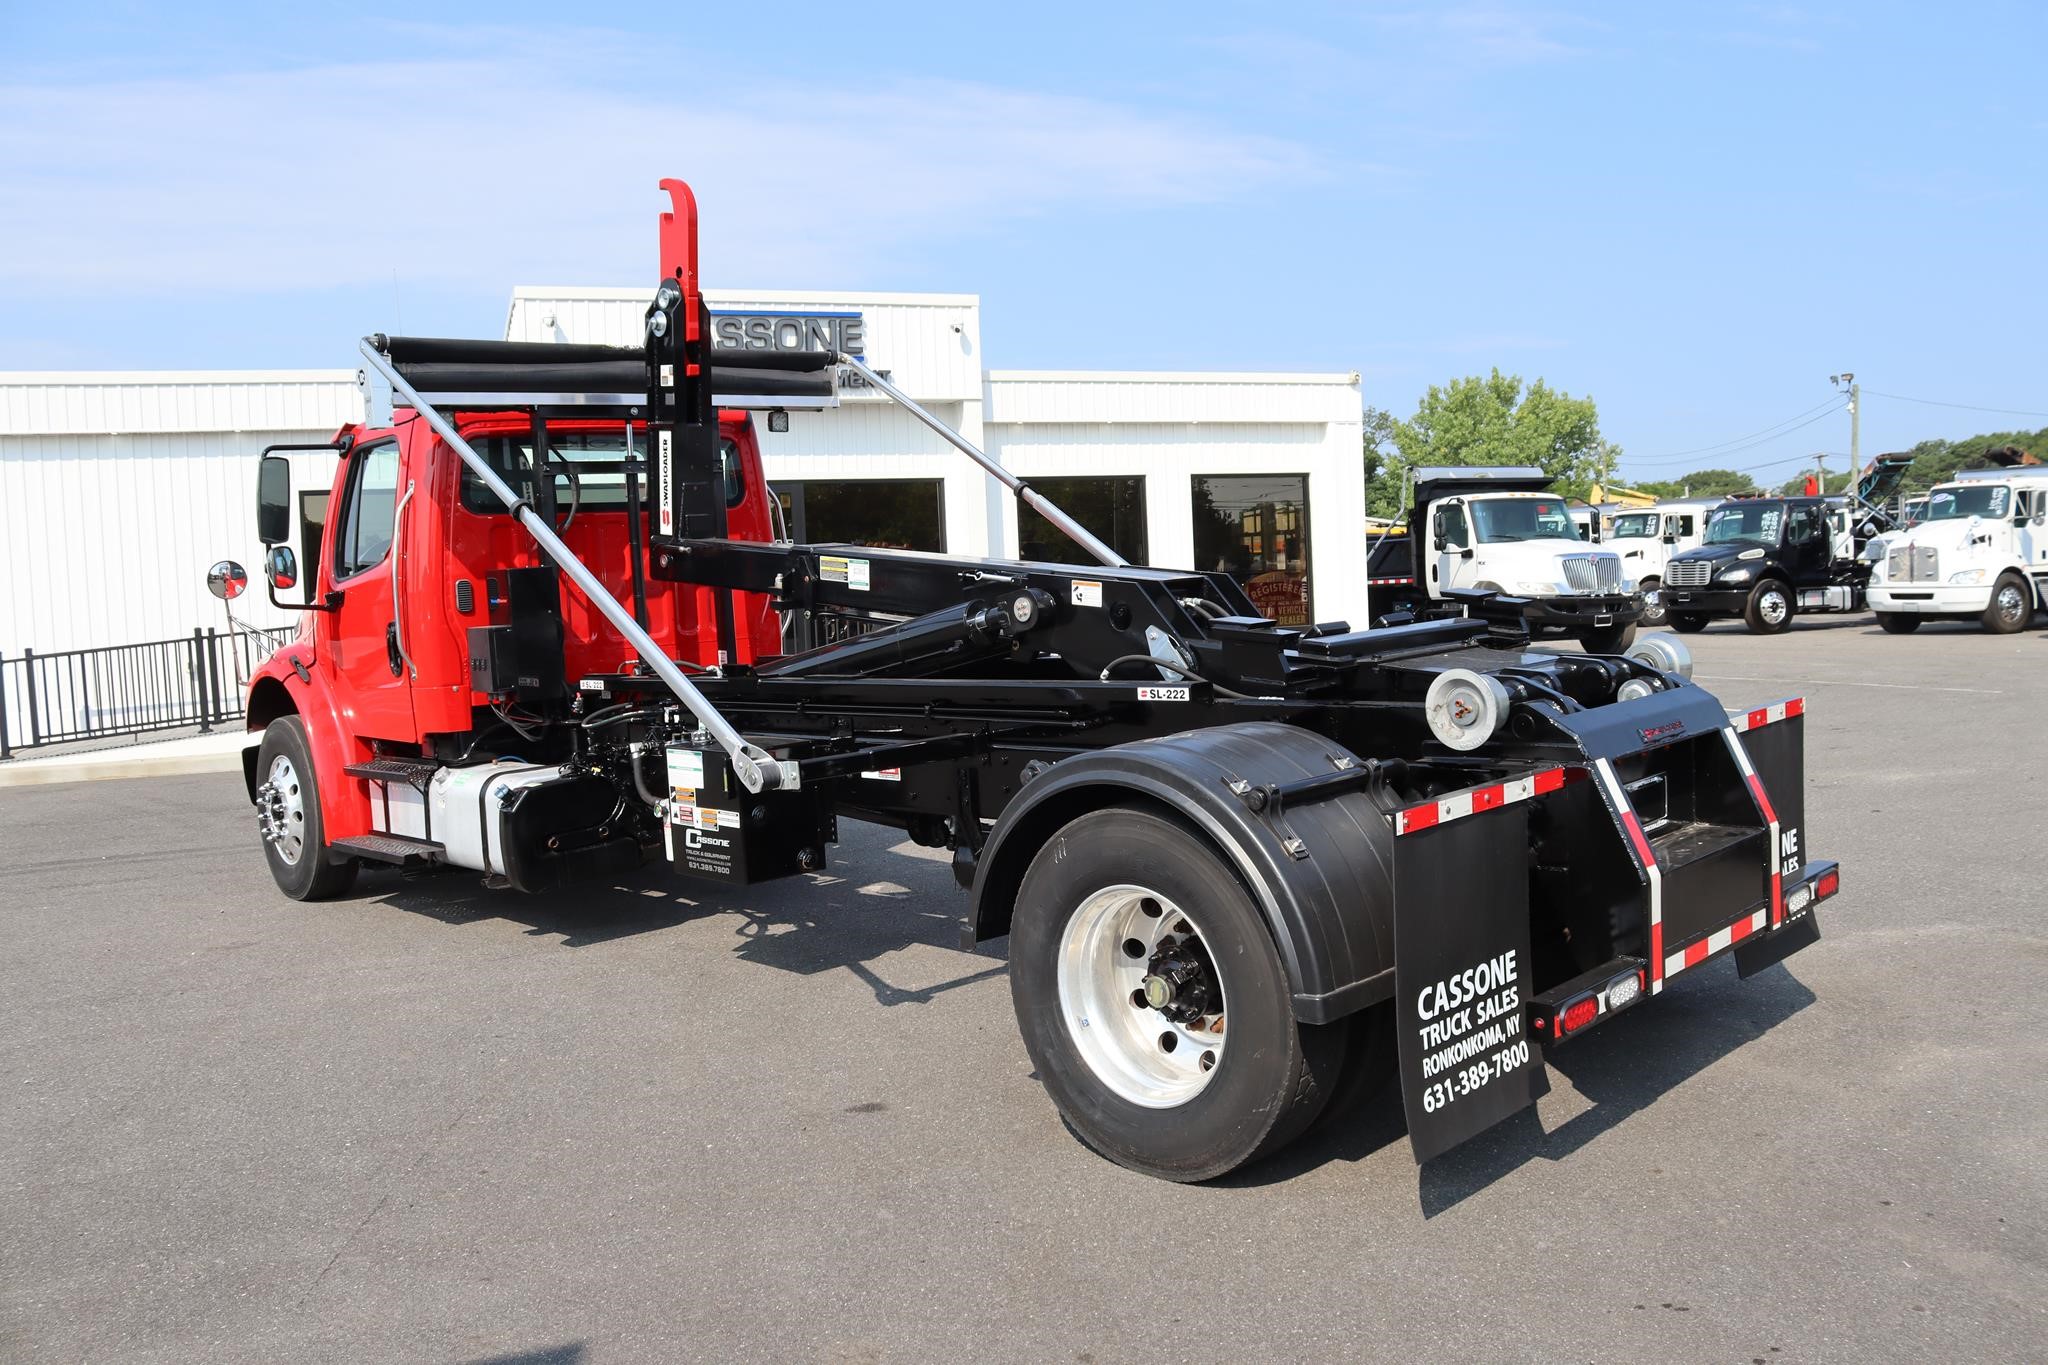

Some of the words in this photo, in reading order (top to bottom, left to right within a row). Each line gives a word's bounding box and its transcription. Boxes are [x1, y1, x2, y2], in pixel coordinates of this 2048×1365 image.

[711, 317, 863, 353] SSONE
[1150, 689, 1186, 699] SL-222
[1782, 856, 1799, 876] LES
[1418, 949, 1518, 1021] CASSONE
[1419, 1007, 1472, 1050] TRUCK
[1477, 986, 1519, 1025] SALES
[1422, 1023, 1506, 1079] RONKONKOMA,
[1506, 1013, 1520, 1038] NY
[1423, 1040, 1529, 1113] 631-389-7800
